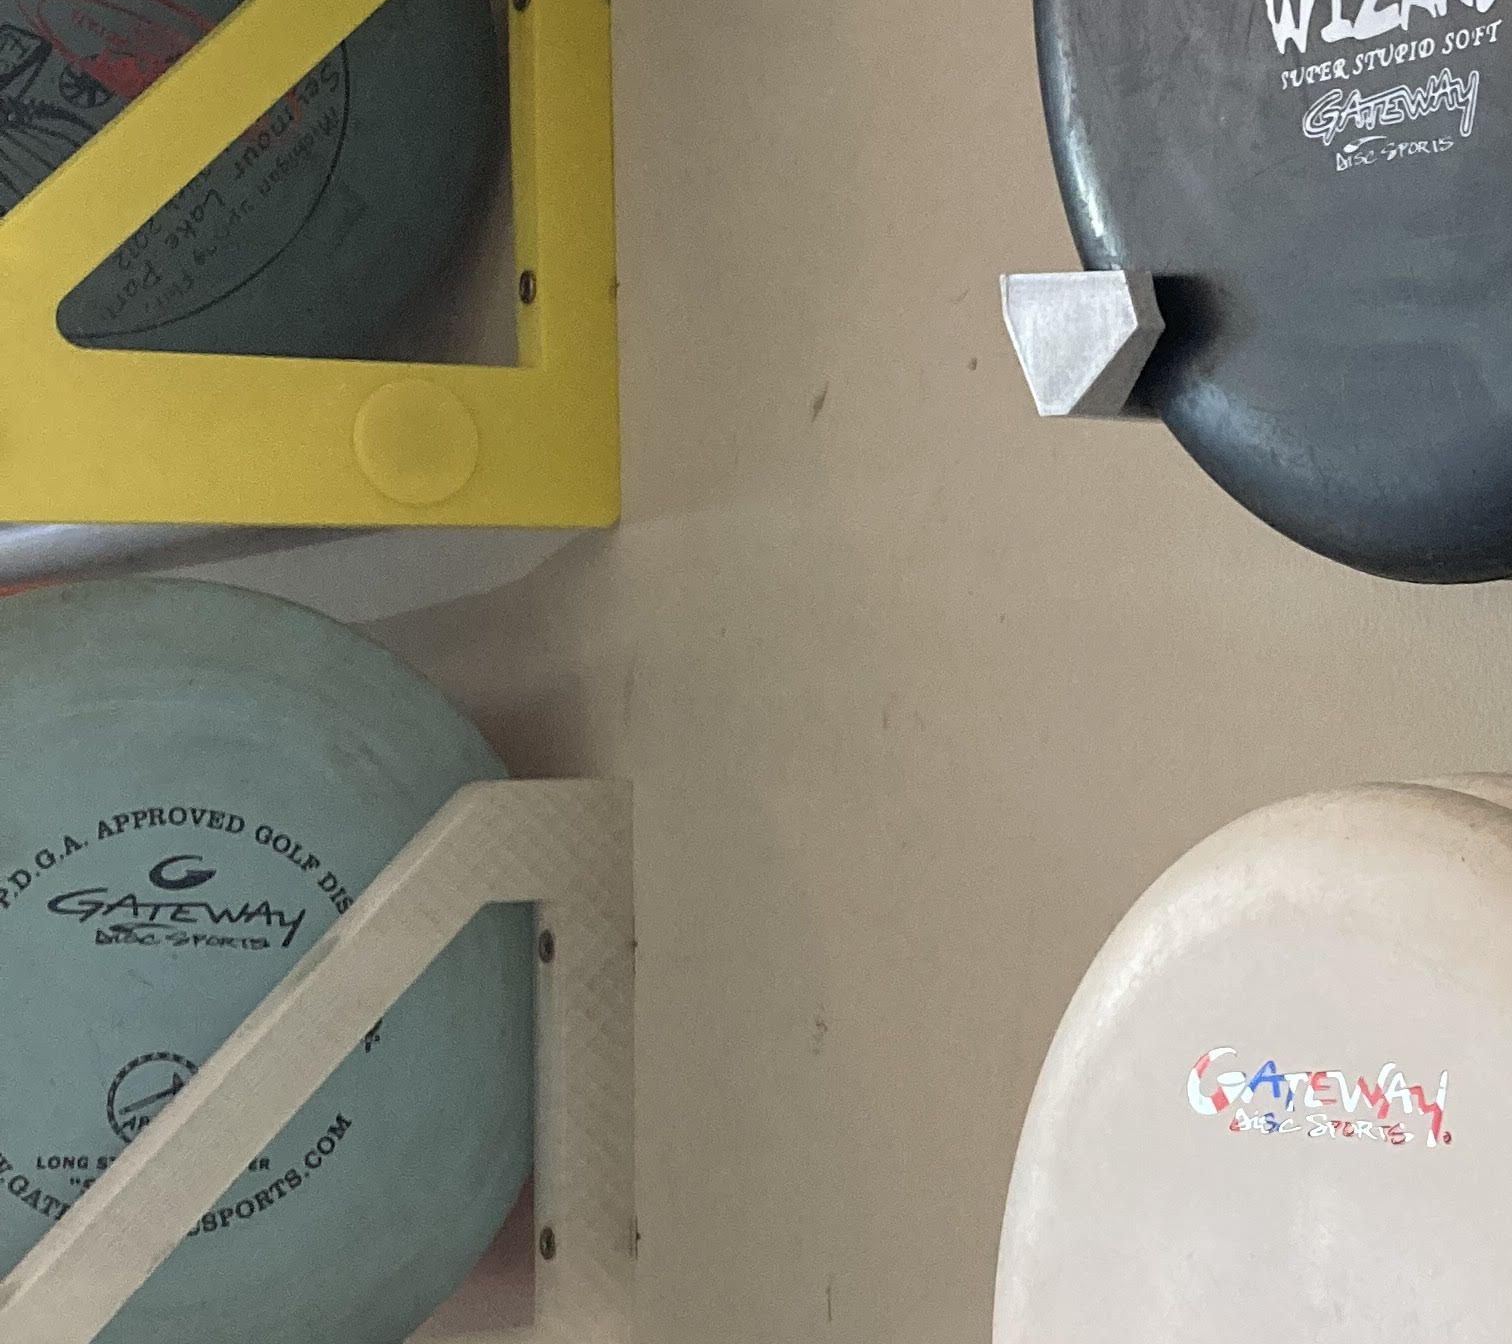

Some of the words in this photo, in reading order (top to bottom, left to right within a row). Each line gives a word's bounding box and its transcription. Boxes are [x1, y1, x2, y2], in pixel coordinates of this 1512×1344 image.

[1281, 58, 1349, 89] SUPER
[1352, 38, 1435, 75] STUPID
[1441, 20, 1502, 54] SOFT
[1302, 68, 1479, 146] GATEWAY
[164, 188, 225, 251] Lake
[97, 806, 246, 839] APPROVED
[254, 824, 321, 873] GOLF
[317, 871, 354, 915] DIS
[47, 888, 306, 947] GATEWAY
[1187, 1046, 1449, 1147] GATEWAY
[36, 1156, 89, 1170] LONG
